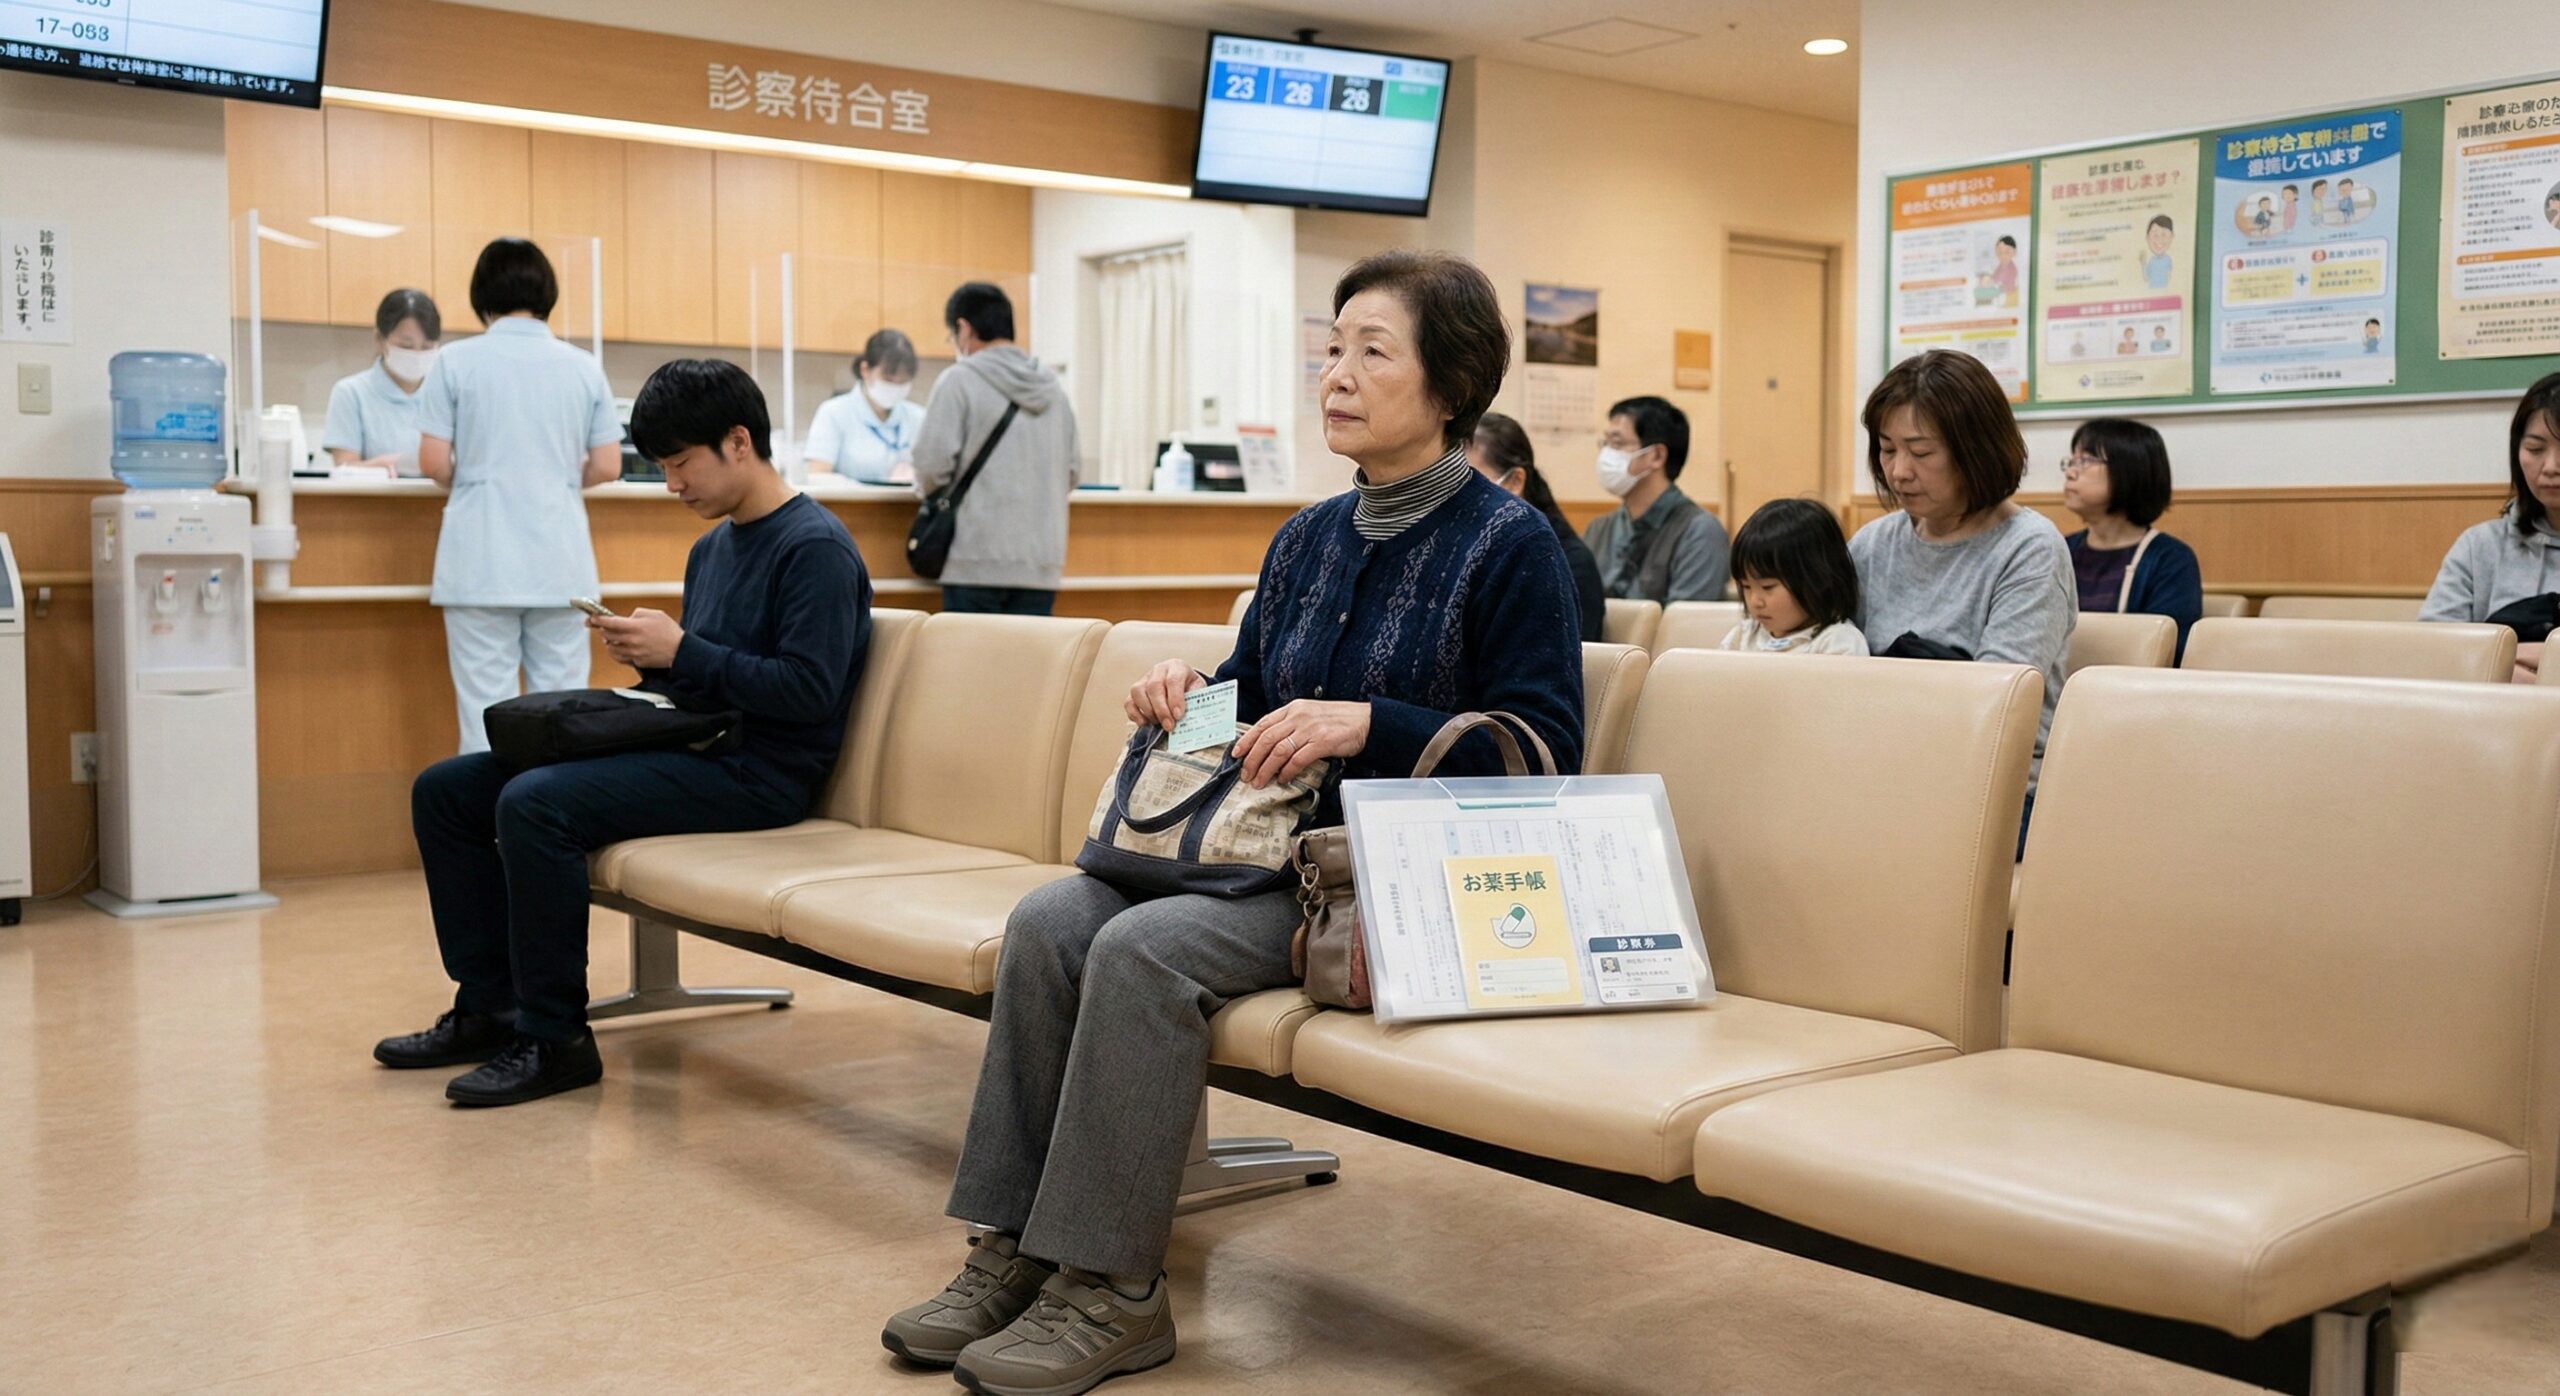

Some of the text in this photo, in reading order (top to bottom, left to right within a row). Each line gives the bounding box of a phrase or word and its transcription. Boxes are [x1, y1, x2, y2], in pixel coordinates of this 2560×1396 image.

[707, 62, 930, 134] 診察待合室
[1226, 75, 1256, 100] 23
[1463, 871, 1546, 892] お薬手帳
